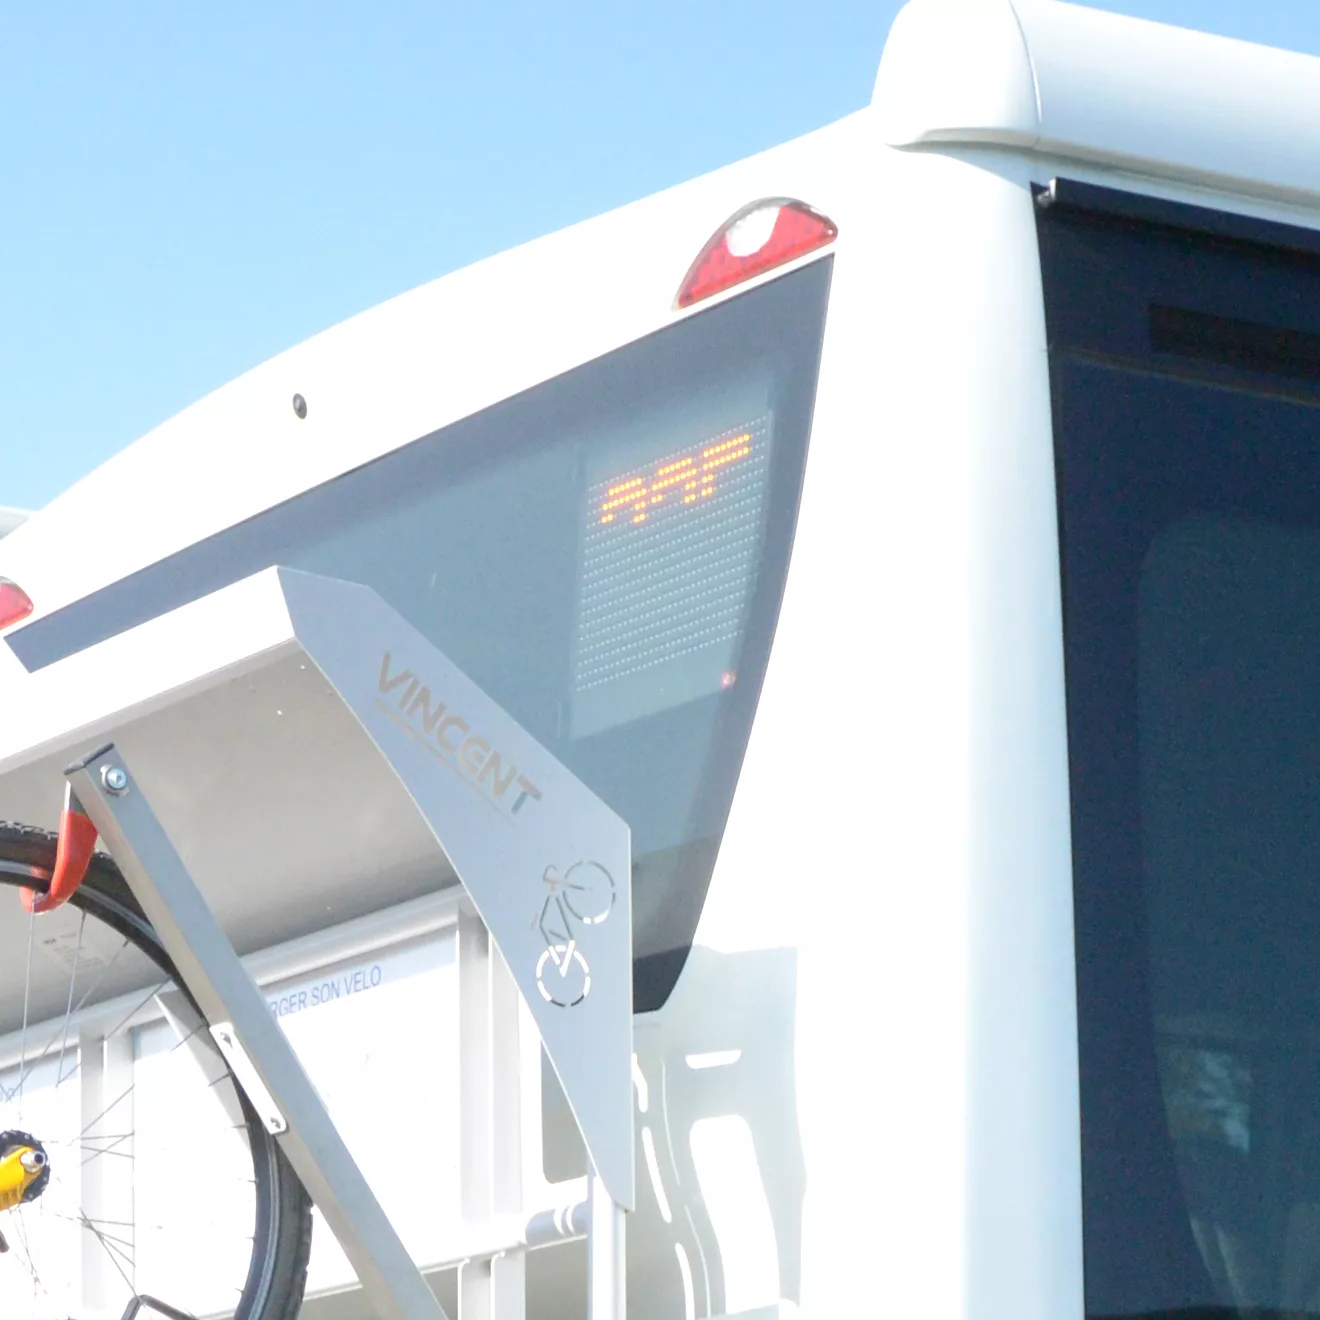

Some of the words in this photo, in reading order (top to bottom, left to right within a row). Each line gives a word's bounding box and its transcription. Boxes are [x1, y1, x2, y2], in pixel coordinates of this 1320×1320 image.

[378, 651, 543, 816] VINCENT
[271, 990, 308, 1019] RGER
[311, 978, 341, 1007] SON
[344, 965, 383, 995] VELO
